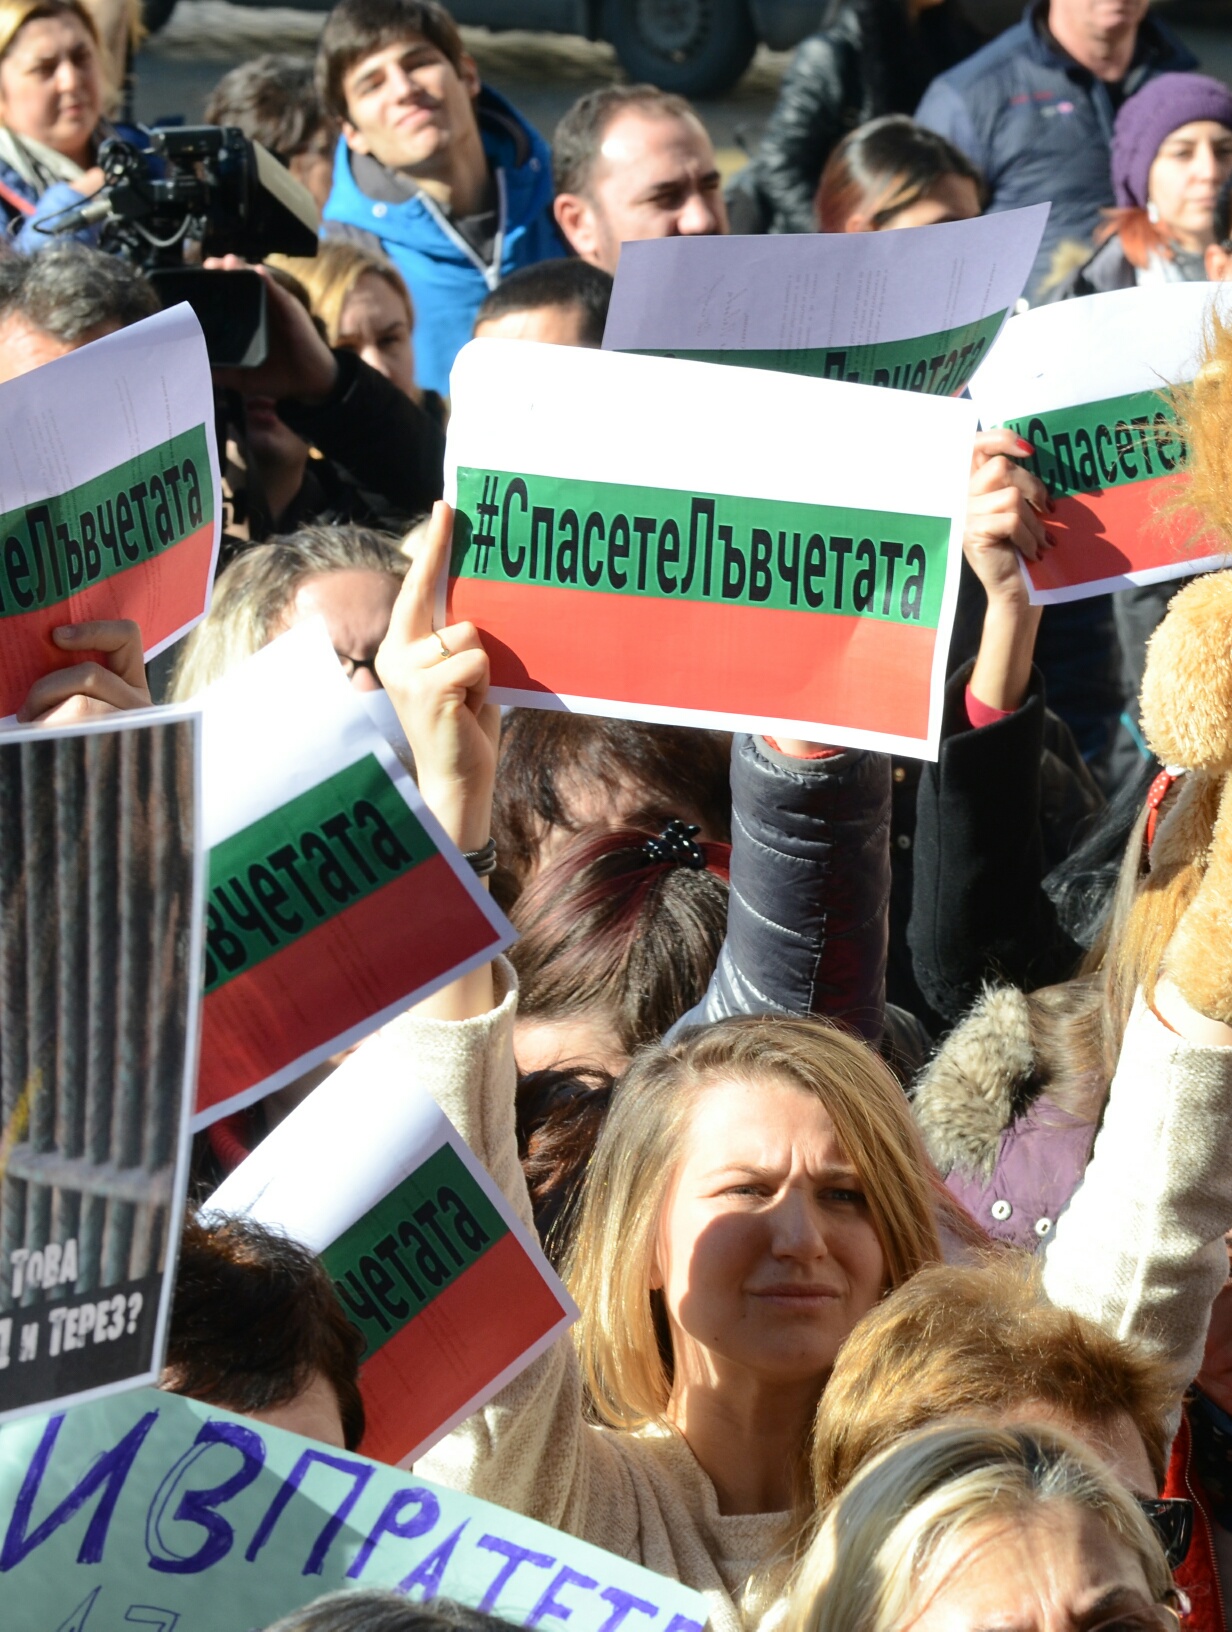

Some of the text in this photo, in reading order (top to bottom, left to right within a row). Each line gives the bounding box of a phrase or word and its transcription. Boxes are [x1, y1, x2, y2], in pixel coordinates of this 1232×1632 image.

[0, 458, 203, 612] еЛъвчетата
[473, 476, 926, 620] #СпасетеЛъвчетата
[205, 800, 414, 988] вчетата
[10, 1238, 78, 1298] ТОВА
[48, 1292, 144, 1357] ТЕРЕЗ?
[335, 1186, 491, 1357] четата
[0, 1408, 704, 1632] ИЗПРАТЕТ
